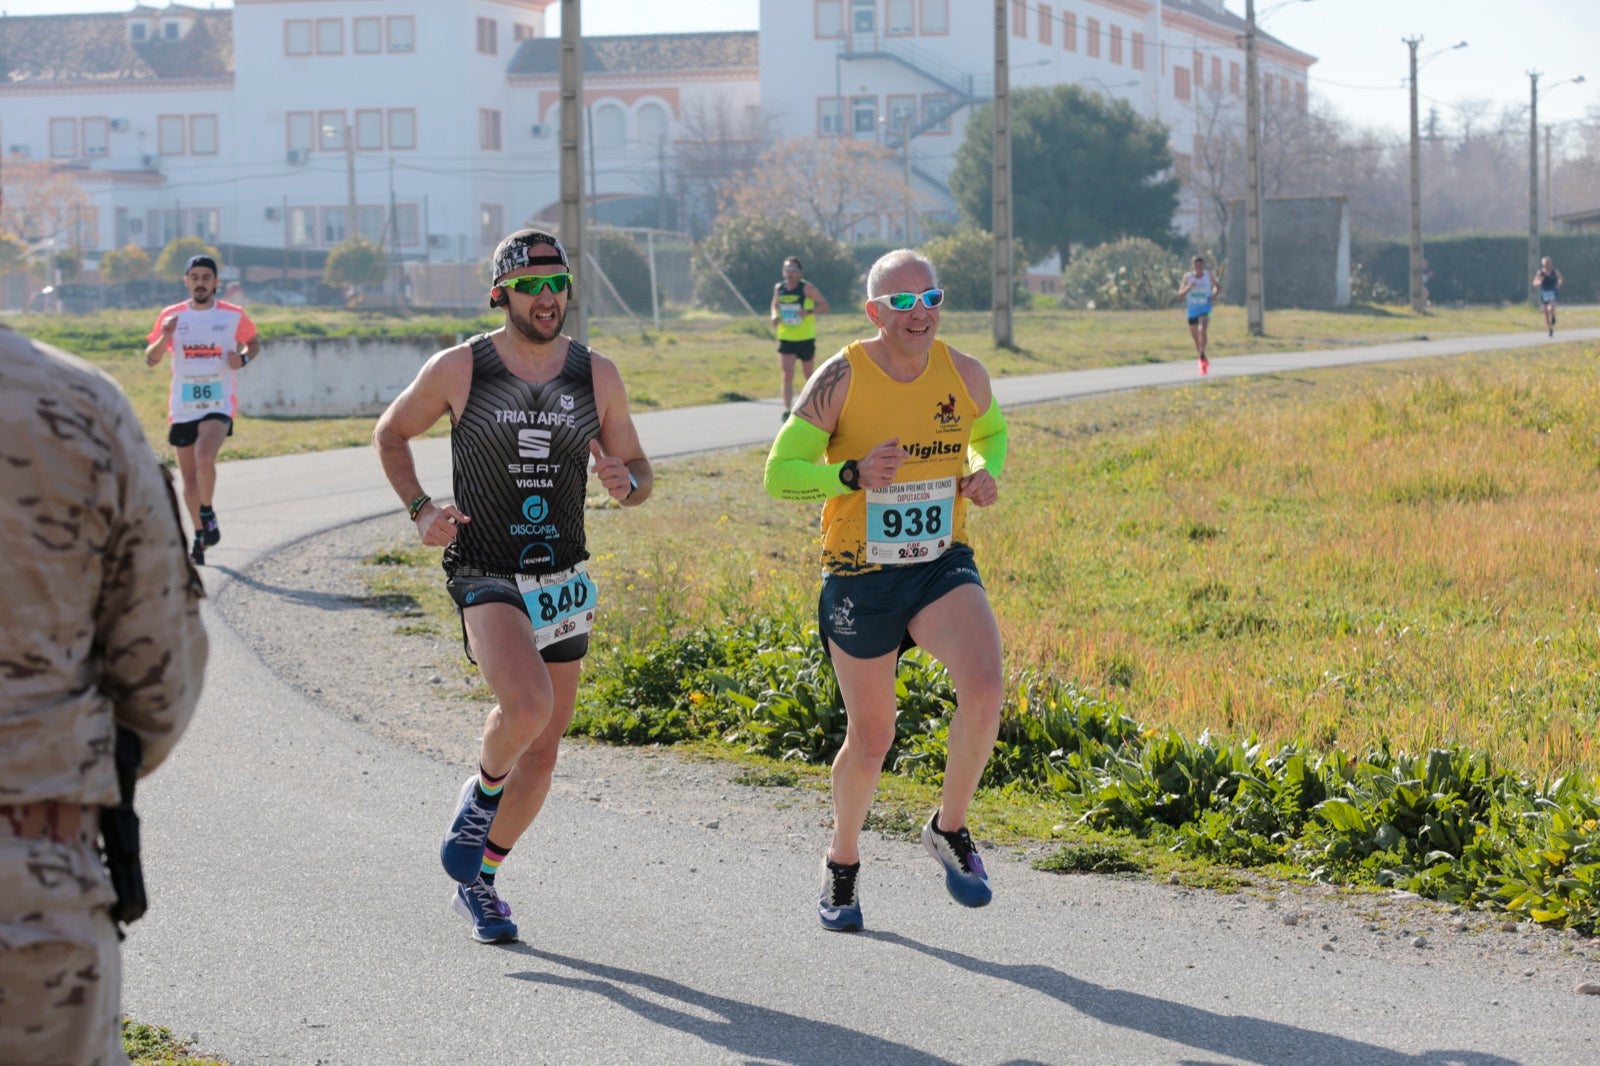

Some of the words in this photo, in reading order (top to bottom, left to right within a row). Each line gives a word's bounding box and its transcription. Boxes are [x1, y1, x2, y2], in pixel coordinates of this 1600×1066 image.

[193, 385, 212, 399] 86
[903, 441, 961, 459] Vigilsa
[508, 463, 560, 473] SEAT
[516, 478, 553, 488] VIGILSA
[889, 484, 905, 494] GRAN
[906, 482, 926, 492] PREMIO
[927, 481, 935, 490] DE
[935, 479, 952, 489] FONDO
[897, 491, 930, 502] DIPUTACIÓN
[882, 505, 942, 538] 938
[538, 581, 588, 622] 840
